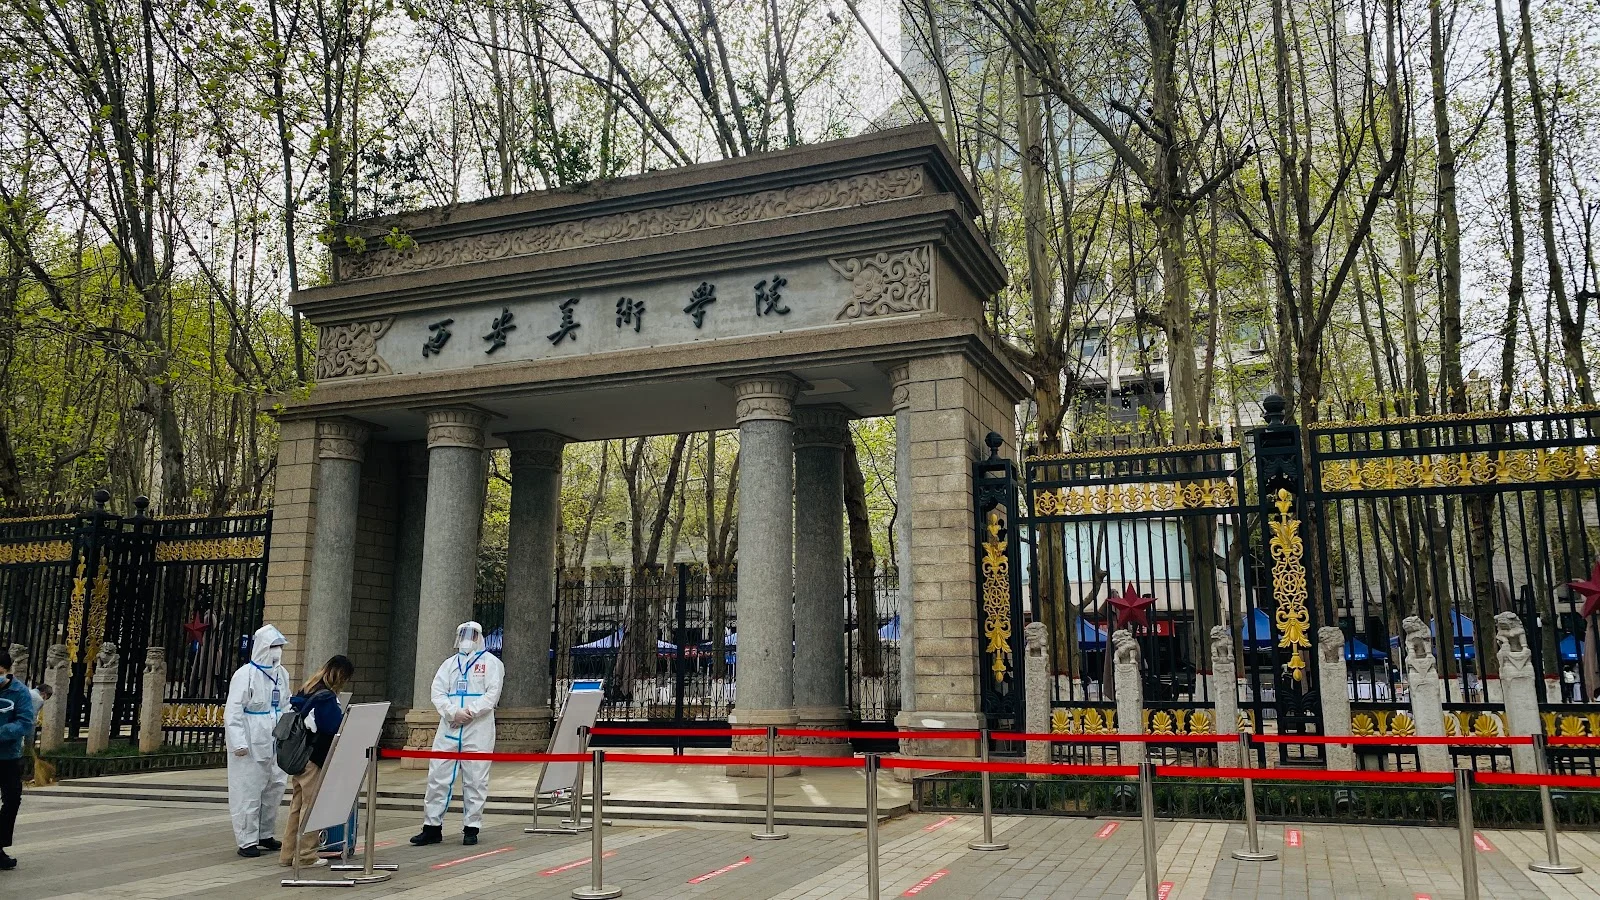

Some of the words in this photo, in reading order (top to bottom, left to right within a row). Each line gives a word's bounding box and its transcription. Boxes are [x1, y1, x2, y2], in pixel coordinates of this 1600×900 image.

[422, 274, 791, 357] 西安美術學院
